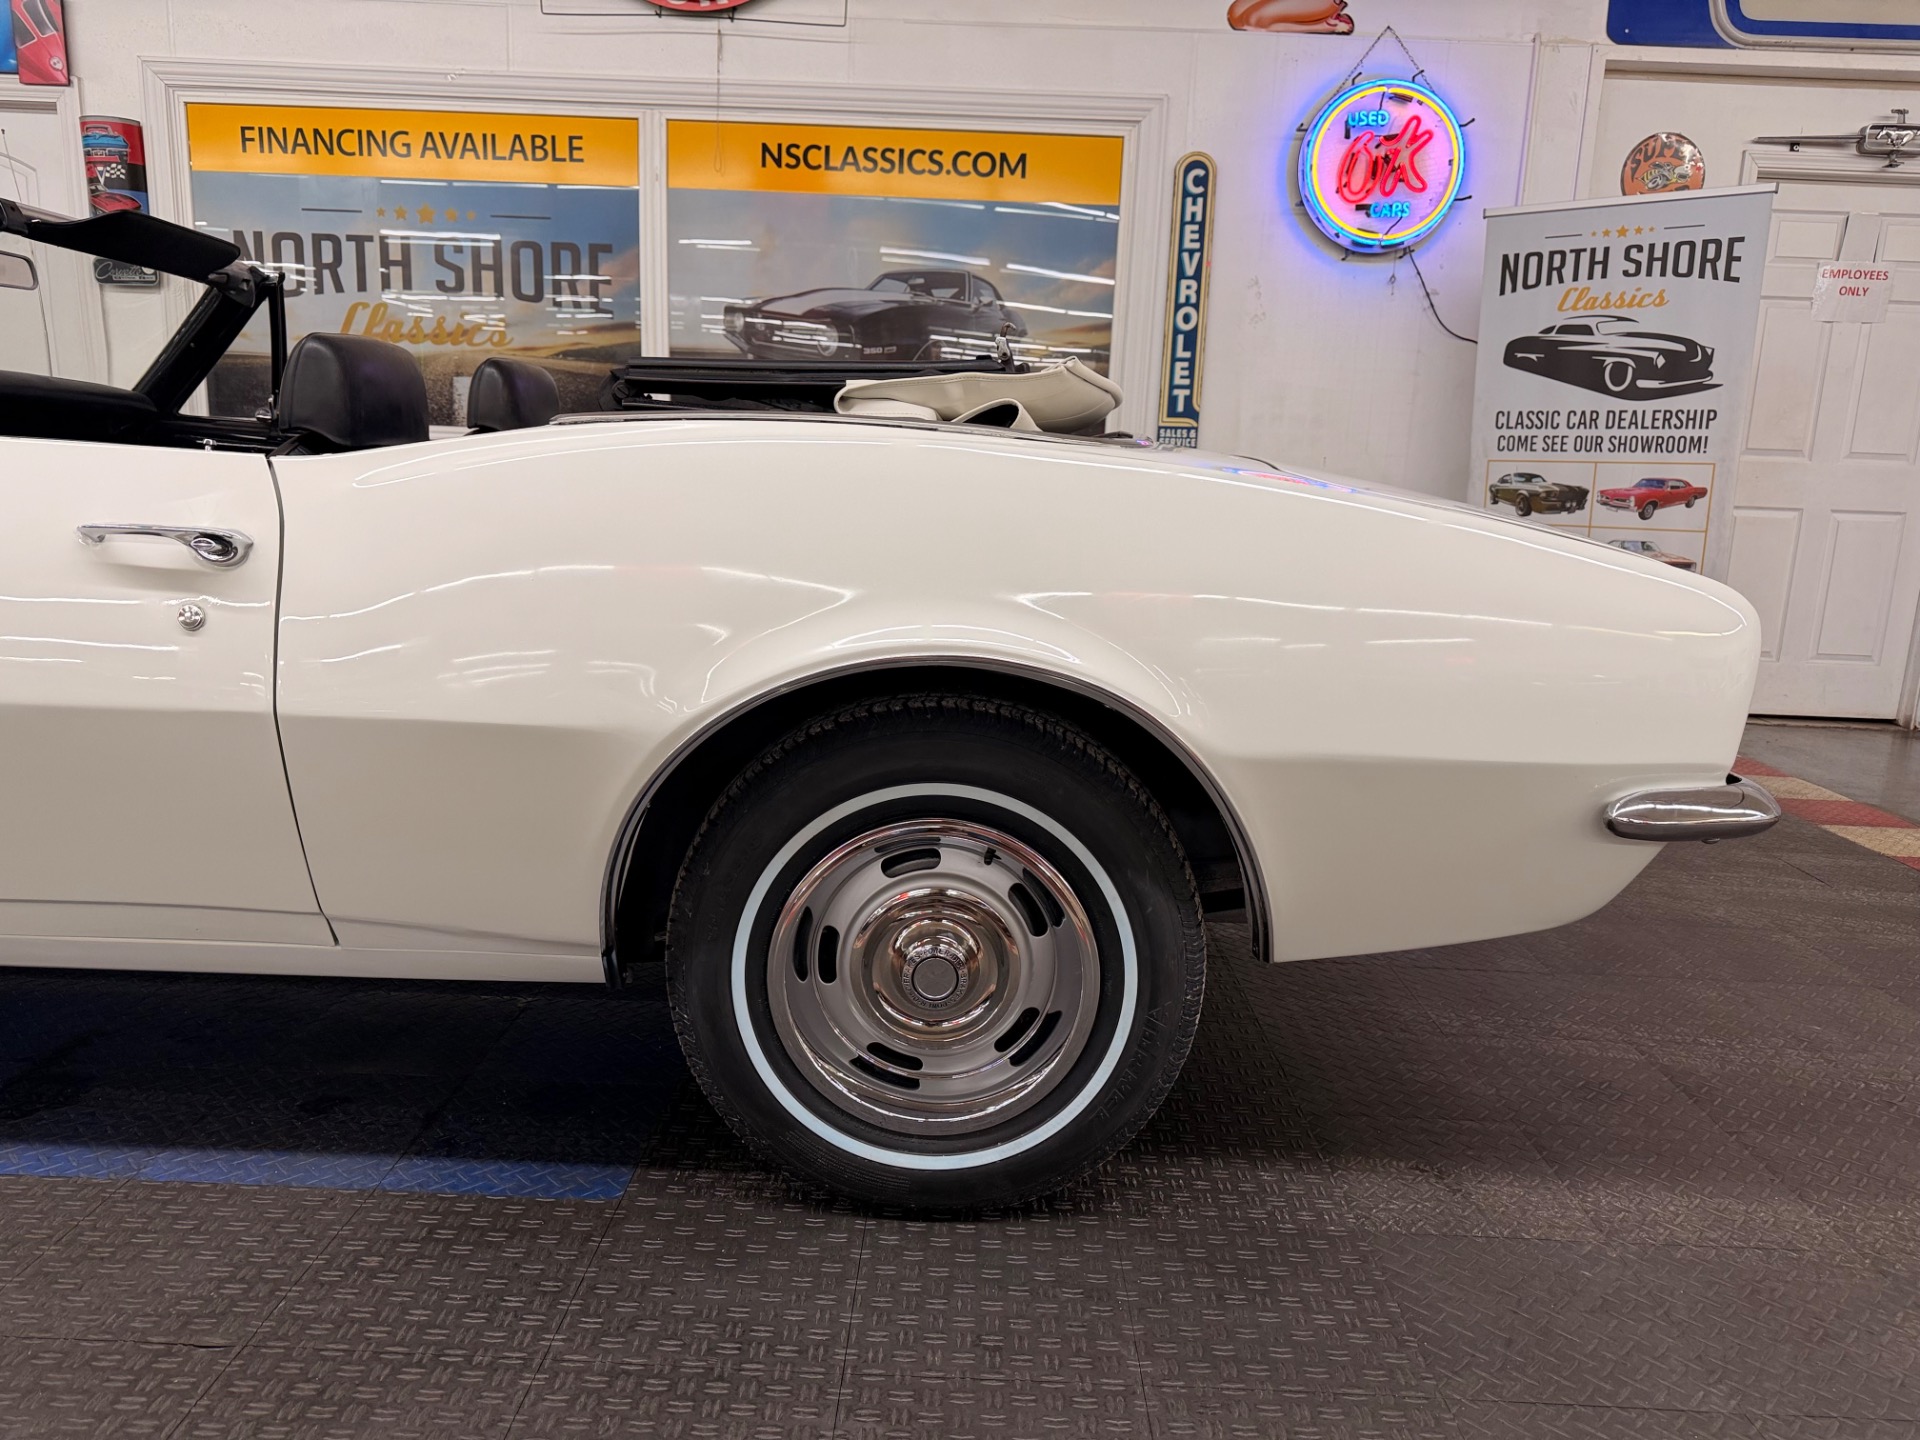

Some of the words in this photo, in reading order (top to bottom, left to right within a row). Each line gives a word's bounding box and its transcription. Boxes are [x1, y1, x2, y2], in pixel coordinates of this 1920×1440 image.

[1347, 109, 1390, 127] USED
[239, 125, 412, 159] FINANCING
[419, 130, 585, 163] AVAILABLE
[760, 141, 1028, 179] NSCLASSICS.COM
[1370, 201, 1411, 218] CARS
[232, 229, 412, 299] NORTH
[434, 236, 614, 319] SHORE
[1498, 245, 1611, 297] NORTH
[1621, 235, 1746, 283] SHORE
[1821, 268, 1889, 281] EMPLOYEES
[1172, 168, 1206, 413] CHEVROLET
[1557, 286, 1670, 312] Classics
[1838, 285, 1870, 297] ONLY
[340, 301, 514, 348] Classics
[1494, 409, 1561, 431] CLASSIC
[1566, 409, 1600, 430] CAR
[1604, 408, 1718, 430] DEALERSHIP
[1159, 438, 1196, 447] SERVICE
[1160, 429, 1187, 437] SALES
[1496, 434, 1539, 453] COME
[1541, 434, 1569, 453] SEE
[1573, 435, 1604, 453] OUR
[1607, 435, 1709, 454] SHOWROOM!
